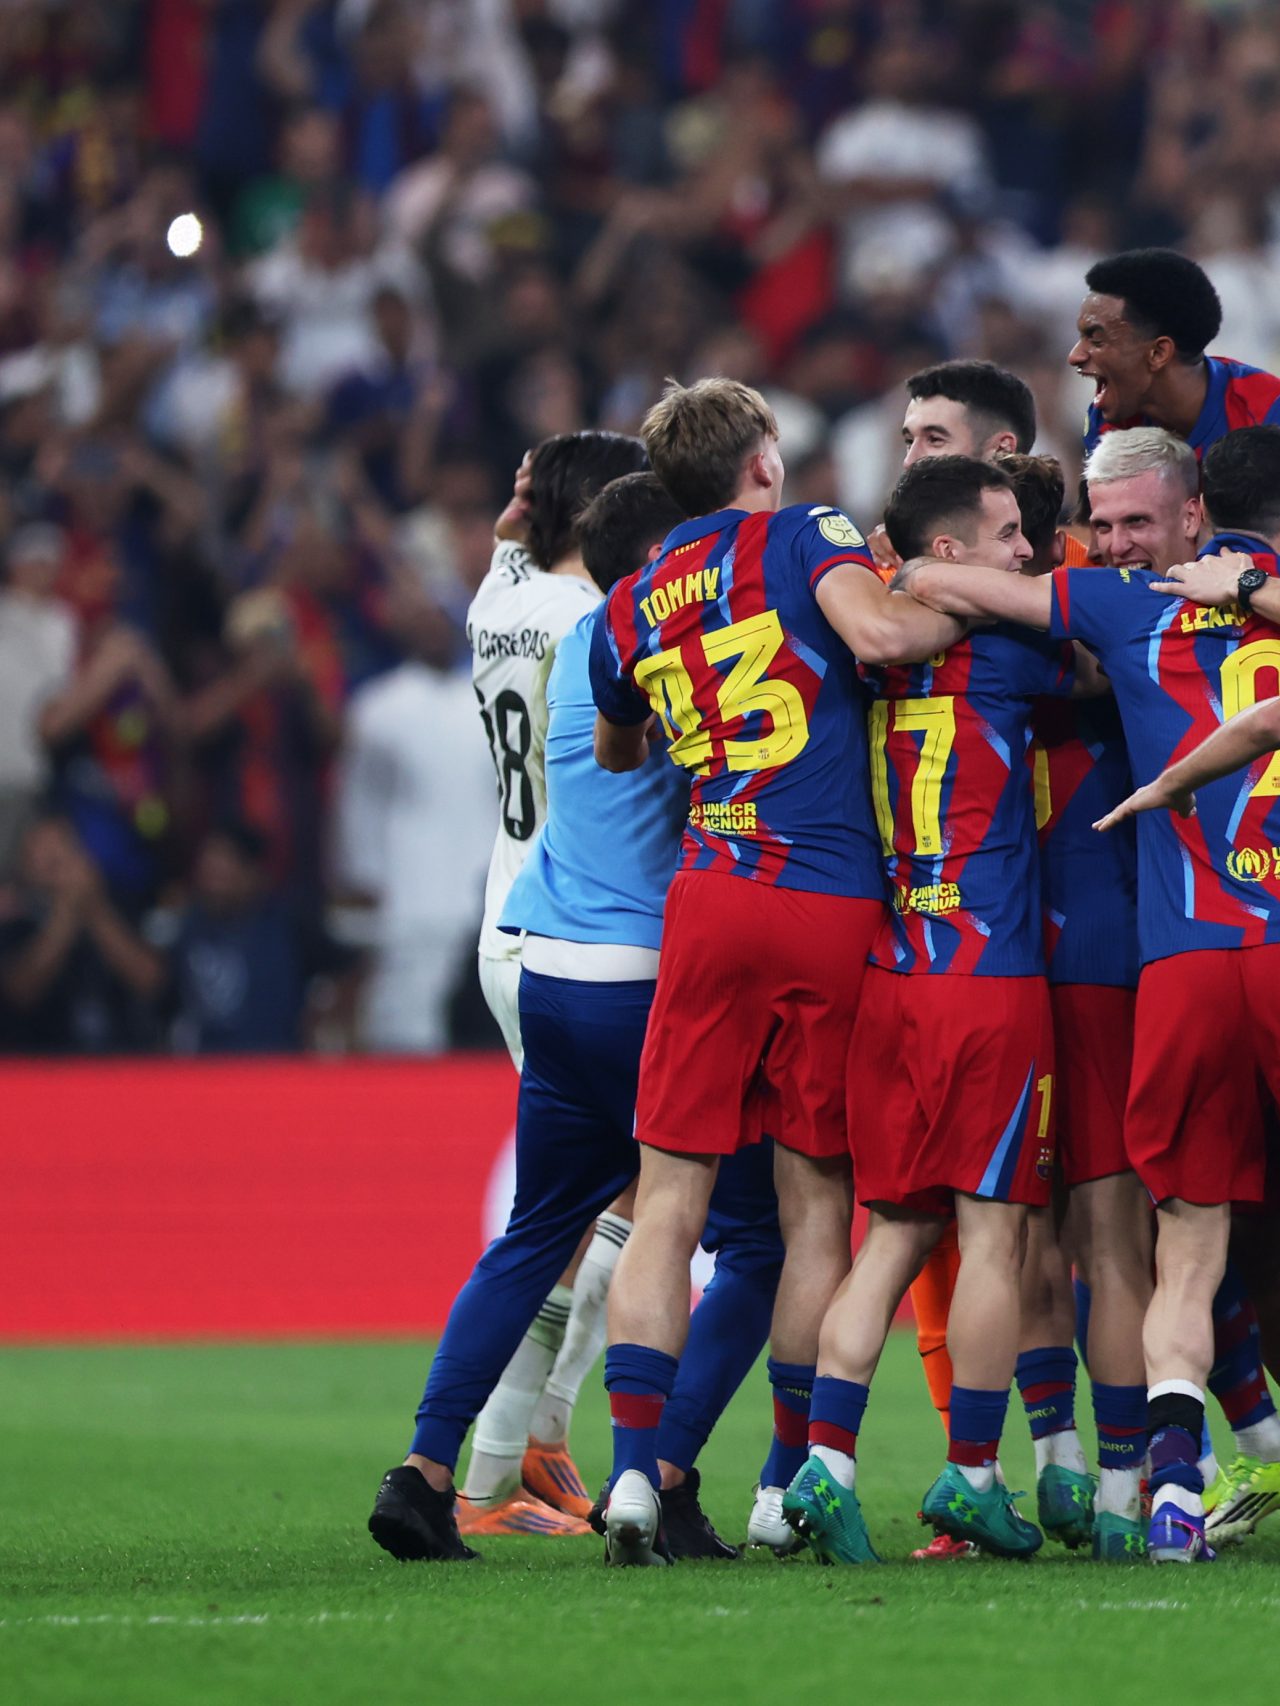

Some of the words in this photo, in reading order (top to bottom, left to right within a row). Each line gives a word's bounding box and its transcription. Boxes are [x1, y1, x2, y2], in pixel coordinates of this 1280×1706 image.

[639, 566, 720, 628] TOMMY
[478, 628, 550, 661] CARERAS
[633, 608, 810, 776] 43
[867, 695, 957, 858] 17
[701, 816, 756, 830] ACNUR
[703, 803, 756, 817] UNHCR
[910, 882, 961, 901] UNHCR
[1036, 1073, 1053, 1138] 1
